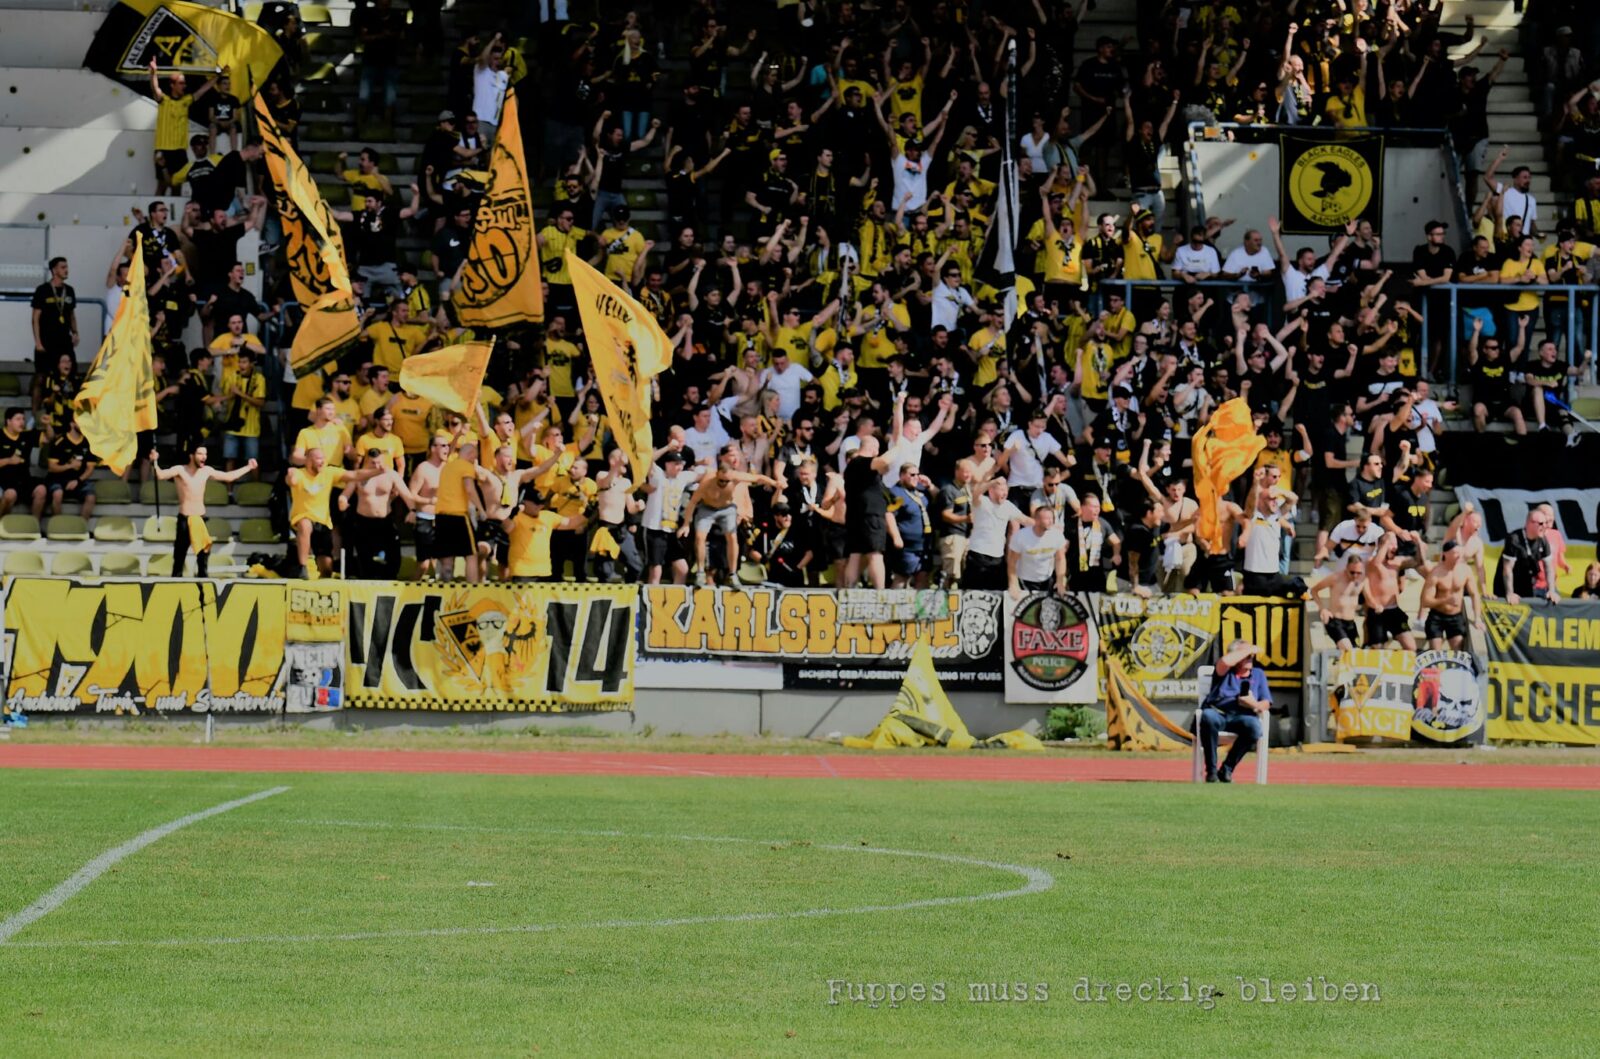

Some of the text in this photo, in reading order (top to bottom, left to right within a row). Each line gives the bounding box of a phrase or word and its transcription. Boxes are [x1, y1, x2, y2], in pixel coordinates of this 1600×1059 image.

[1297, 146, 1366, 169] BLACK EAGLES
[1311, 214, 1351, 226] AACHEN
[1147, 596, 1213, 617] STADT
[546, 598, 632, 693] 14
[1018, 628, 1084, 652] FAXE
[1032, 656, 1067, 667] POLICE
[959, 672, 976, 681] MIT
[977, 672, 1002, 682] GUSS
[1337, 710, 1408, 736] ONCE
